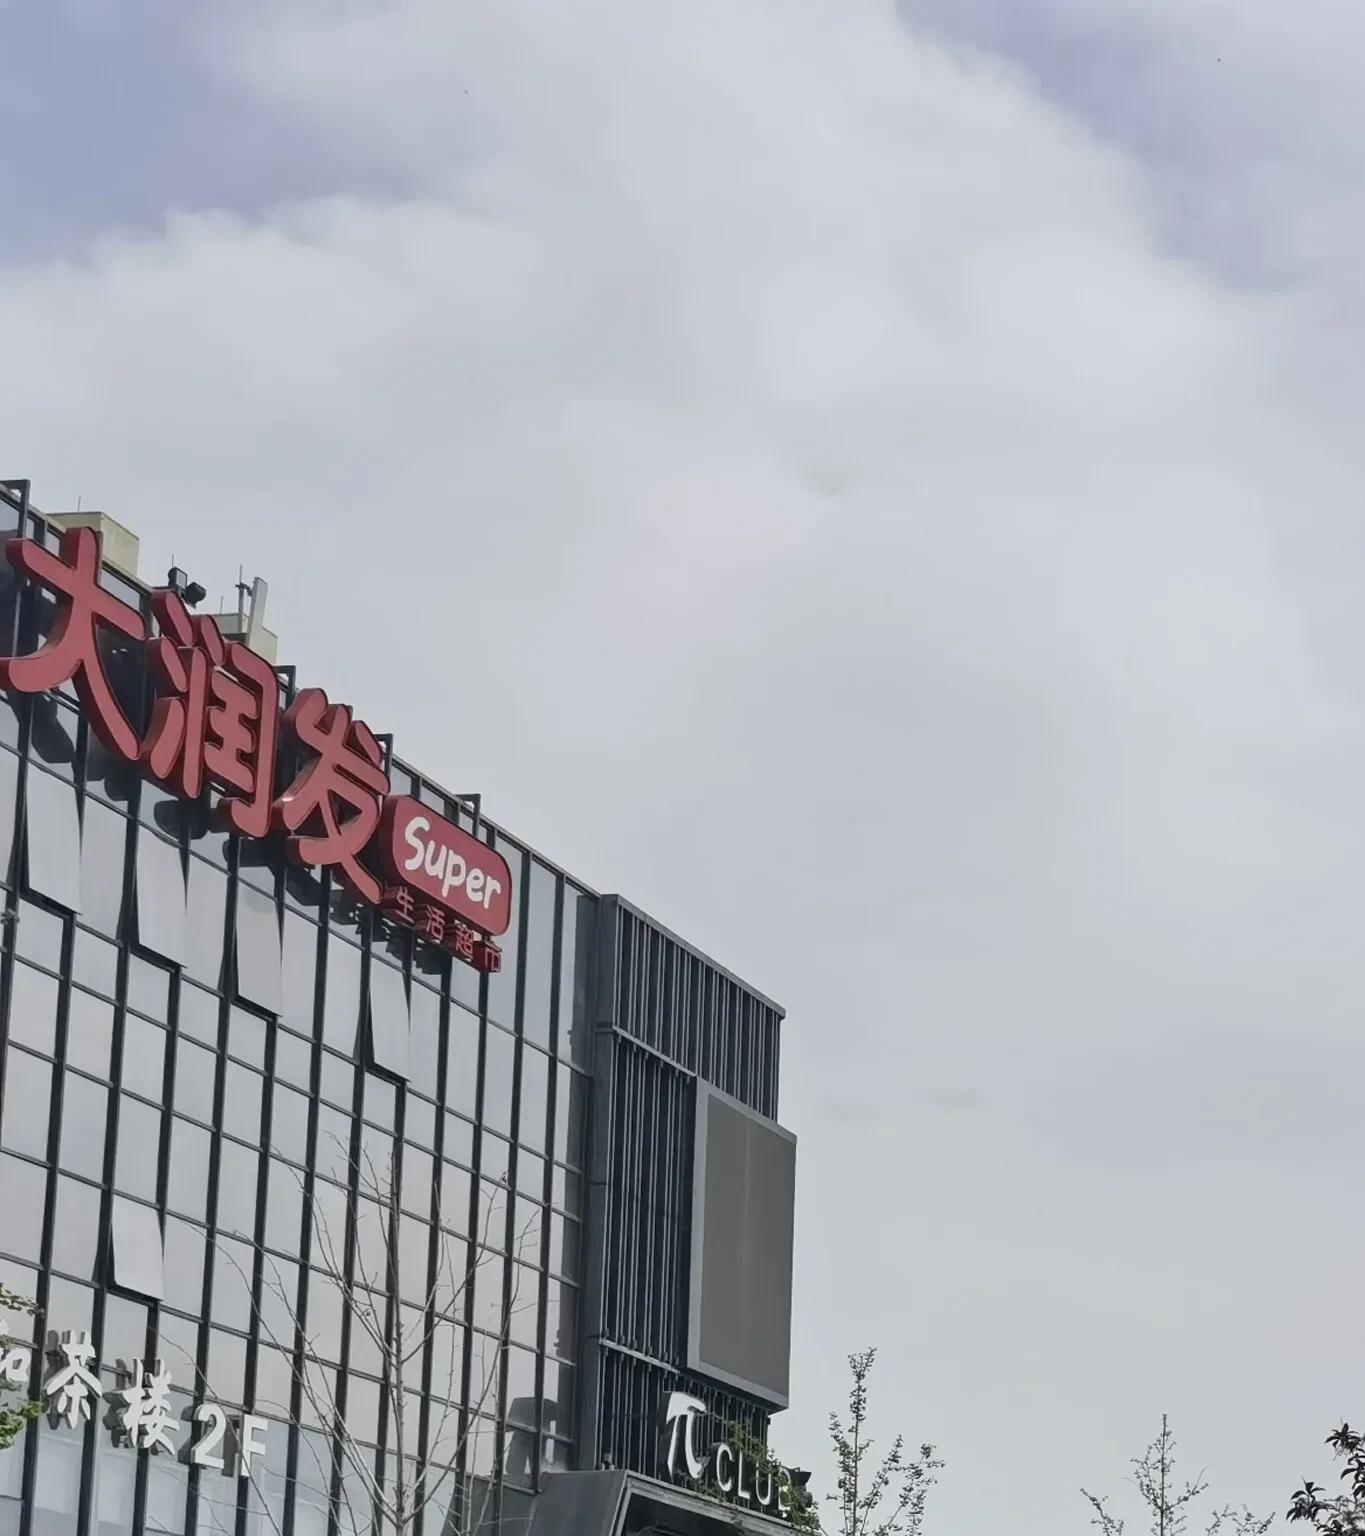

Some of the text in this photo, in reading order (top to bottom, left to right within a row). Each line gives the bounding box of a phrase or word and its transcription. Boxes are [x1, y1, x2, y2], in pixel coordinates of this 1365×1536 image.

[0, 526, 390, 906] 大润发
[404, 816, 501, 910] Super
[395, 886, 501, 974] 生活超市
